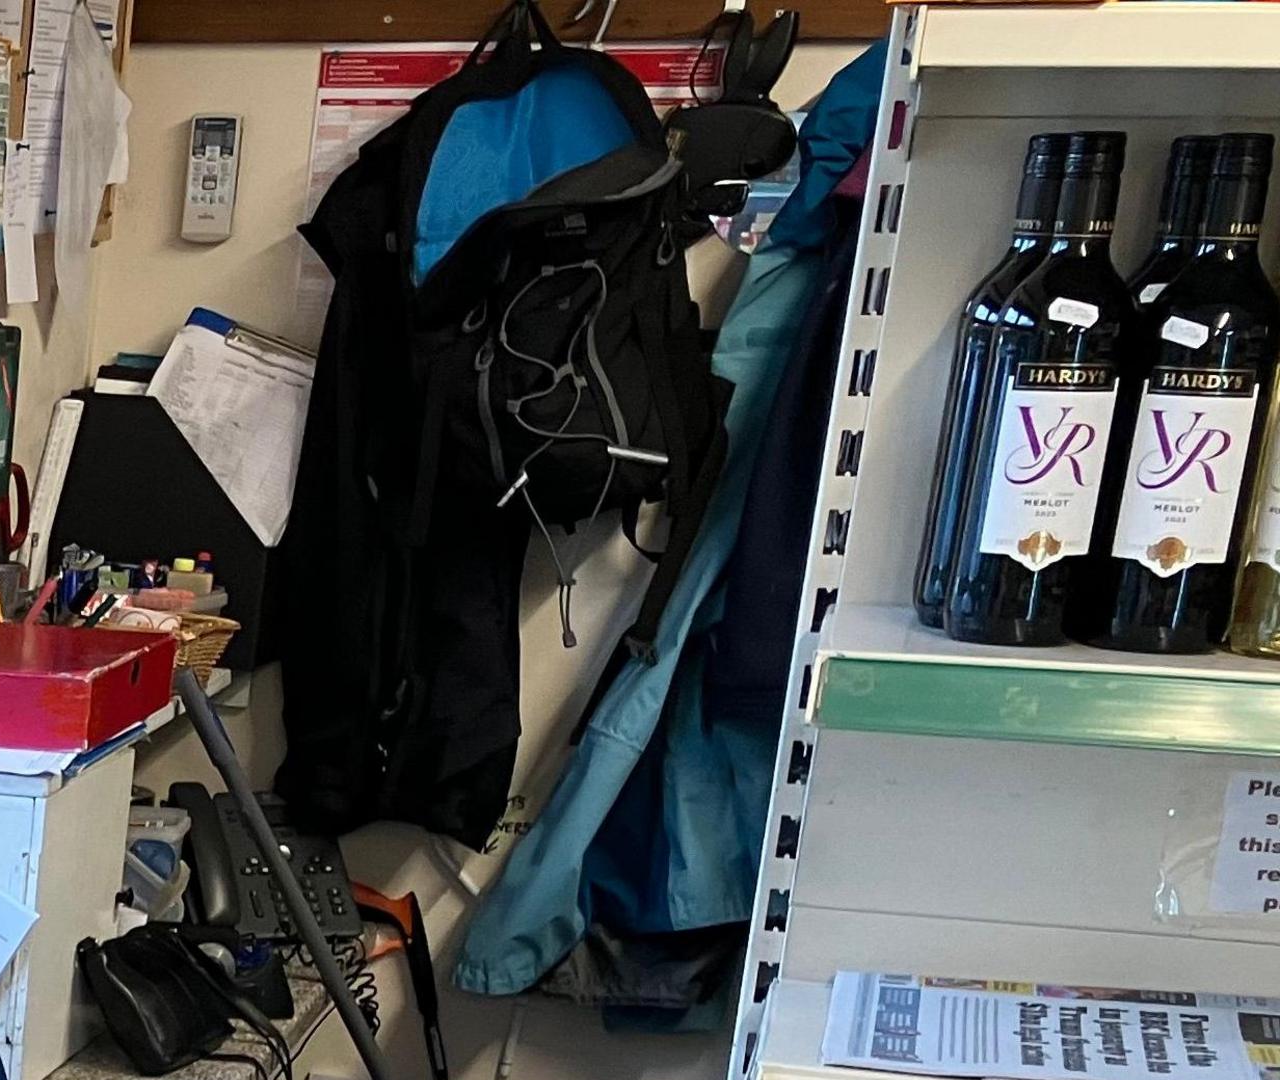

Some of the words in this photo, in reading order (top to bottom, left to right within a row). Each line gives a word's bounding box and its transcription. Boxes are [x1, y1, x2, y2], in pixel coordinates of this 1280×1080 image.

[1004, 405, 1100, 488] VR
[1136, 409, 1234, 494] VR
[1024, 499, 1069, 508] MERLOT
[1153, 504, 1200, 513] MERLOT
[1248, 780, 1280, 797] Ple
